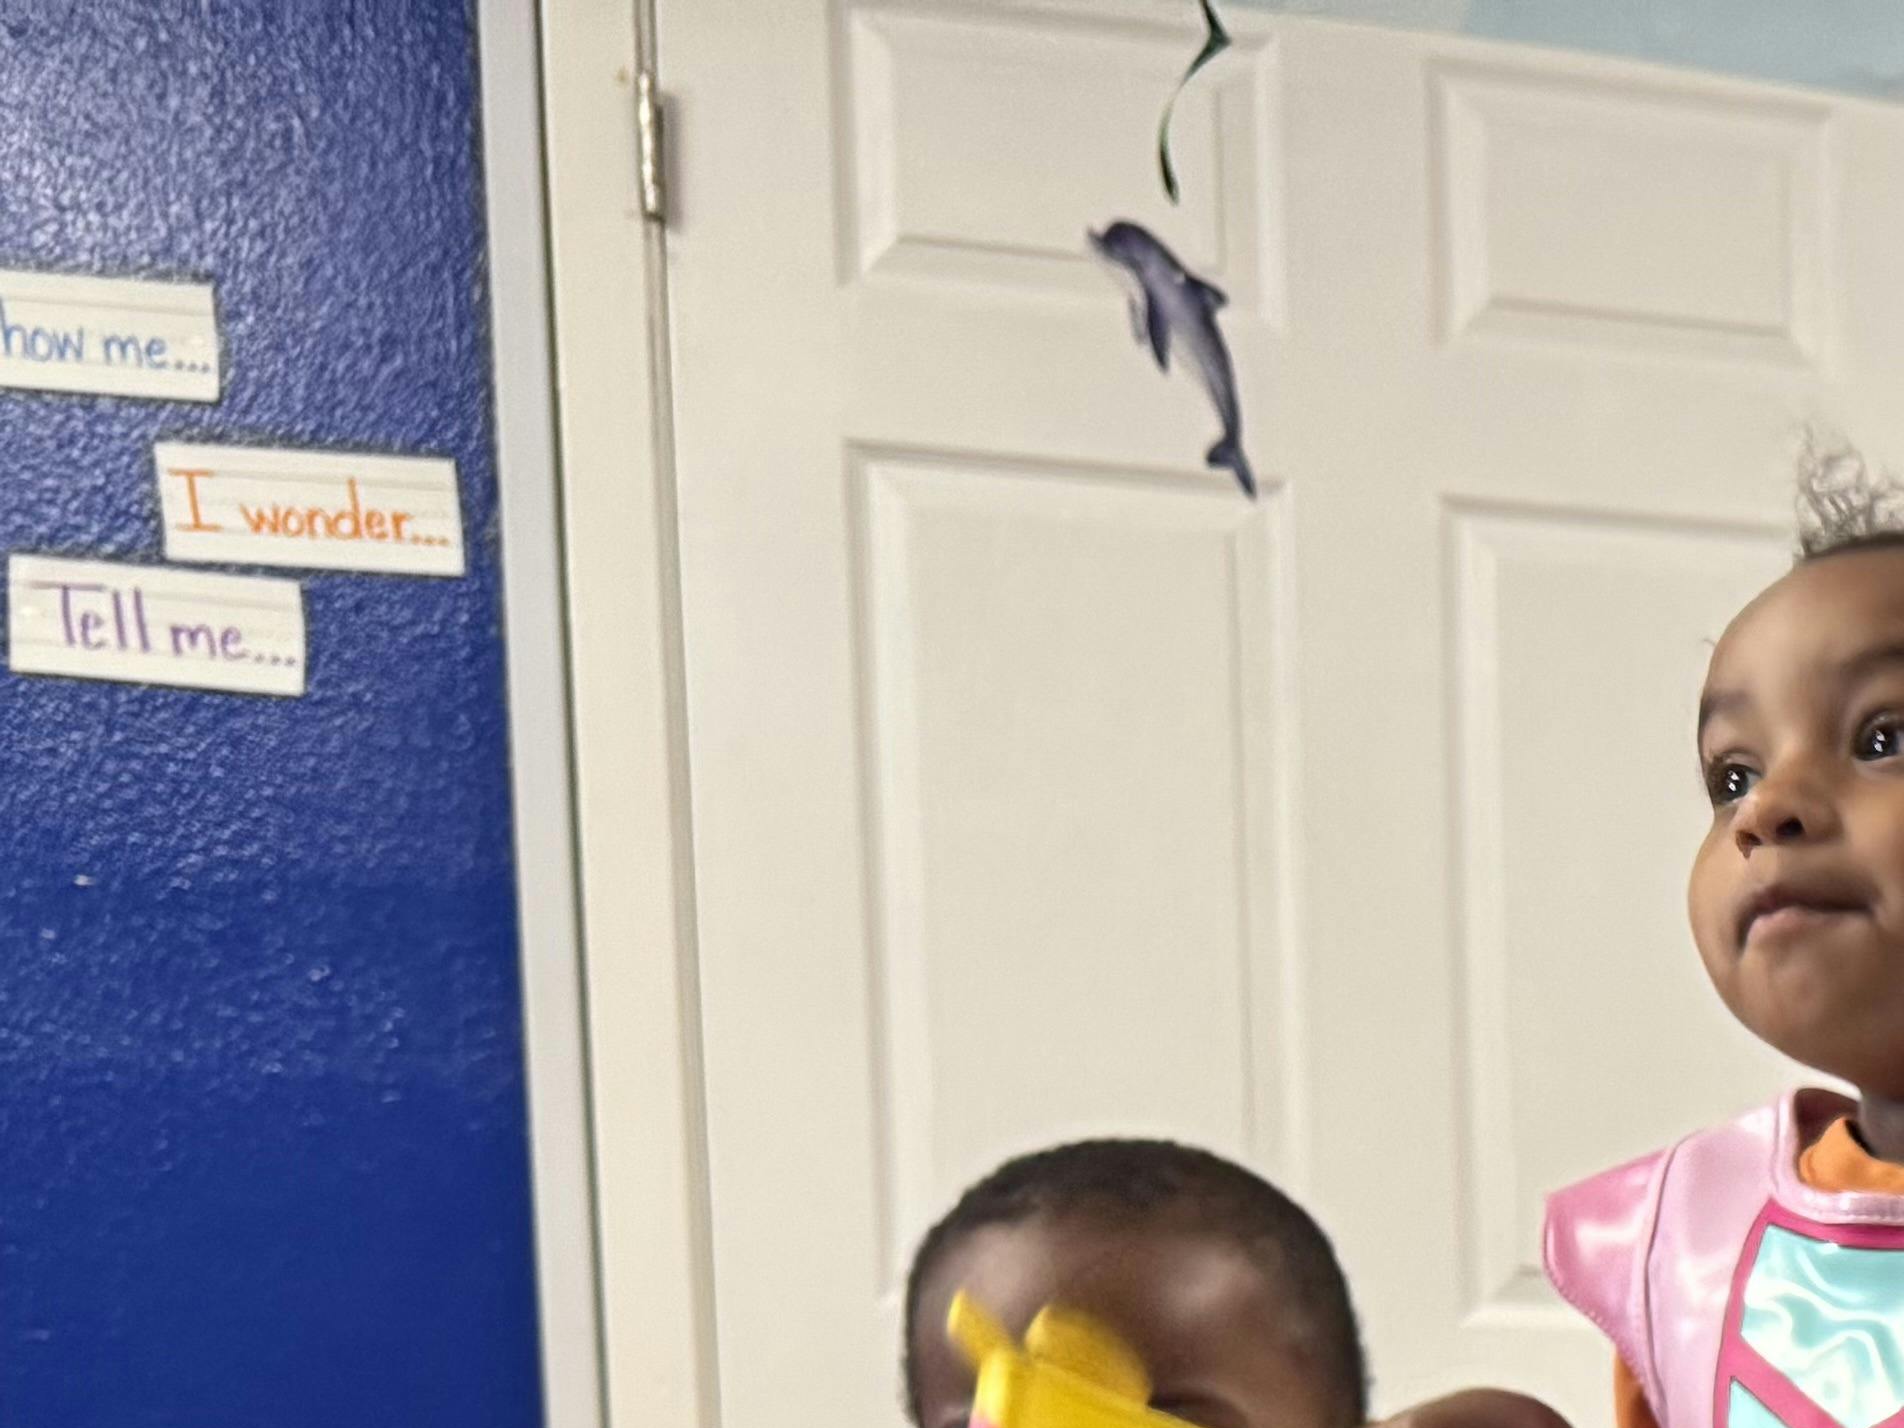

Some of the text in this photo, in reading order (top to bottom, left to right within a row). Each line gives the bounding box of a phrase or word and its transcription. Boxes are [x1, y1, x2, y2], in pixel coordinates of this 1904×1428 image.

[168, 469, 451, 548] I wonder...
[28, 581, 298, 668] Tell me...
